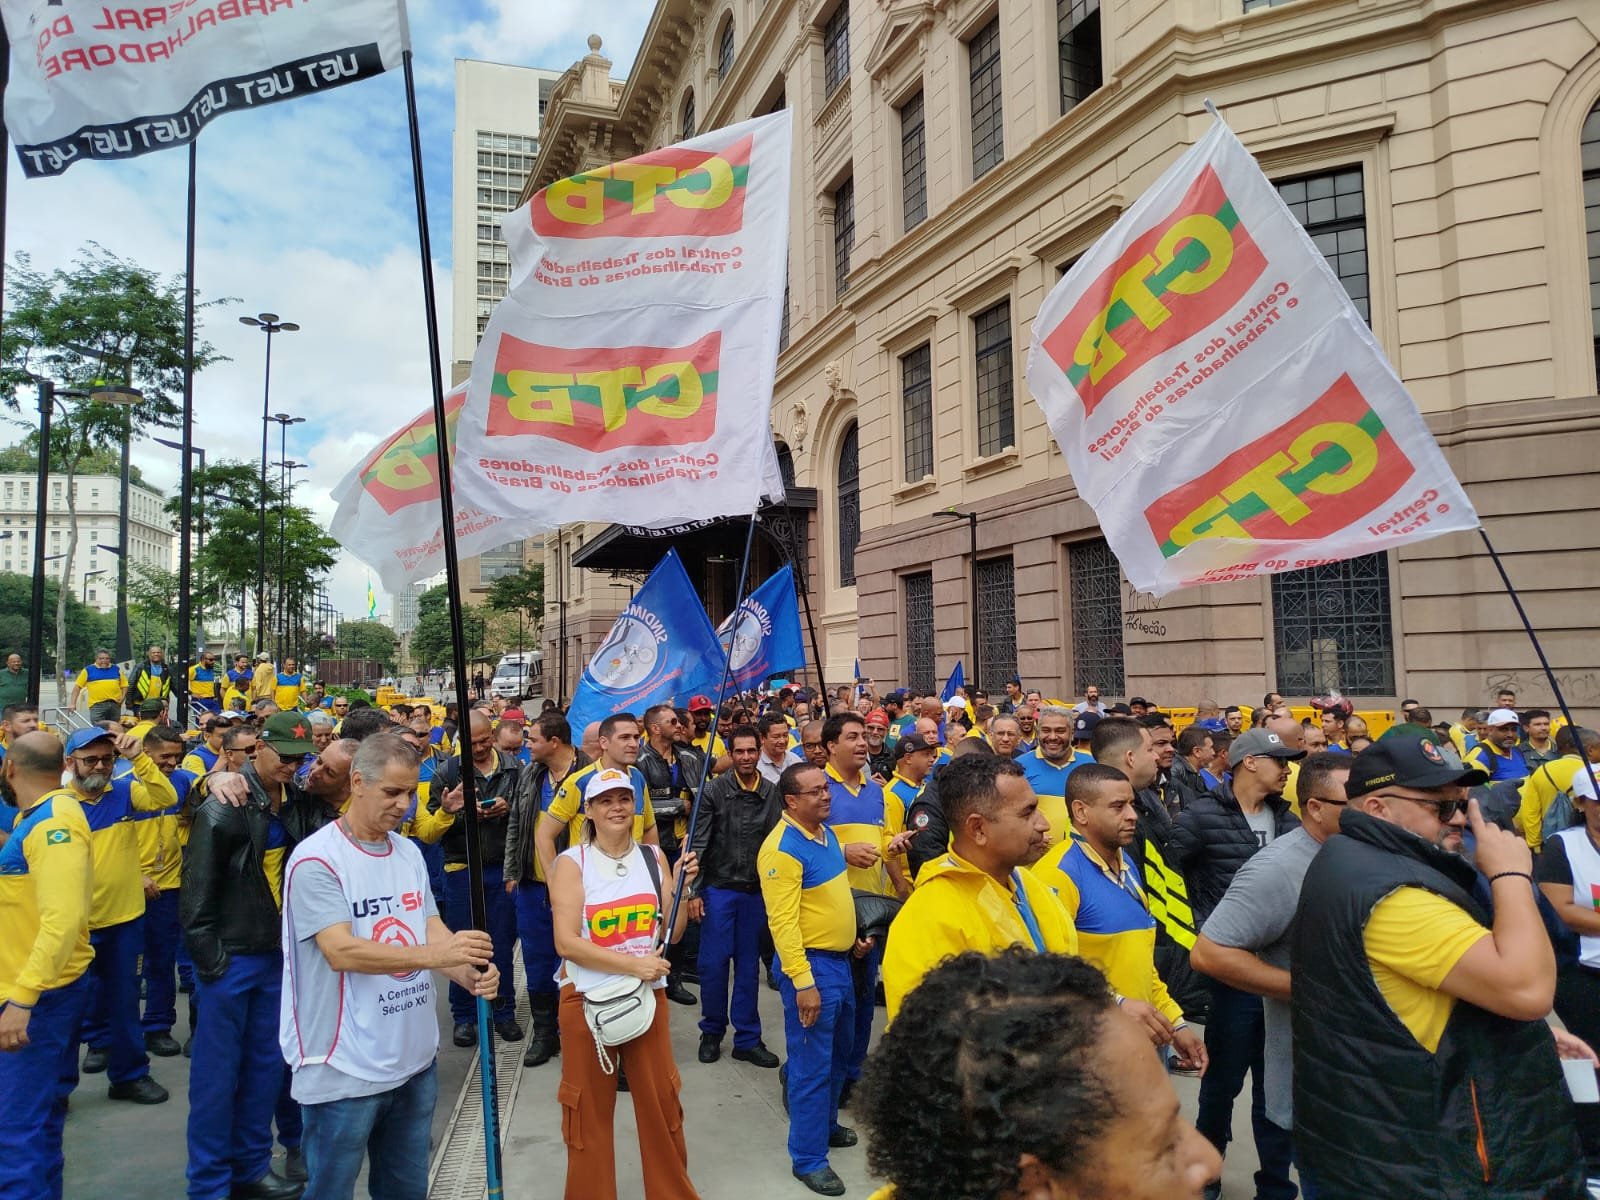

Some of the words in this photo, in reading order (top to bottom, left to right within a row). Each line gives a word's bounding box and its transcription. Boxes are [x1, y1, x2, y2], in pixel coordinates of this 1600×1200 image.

[1264, 559, 1288, 570] do
[591, 904, 656, 938] CTB
[379, 993, 385, 1004] A
